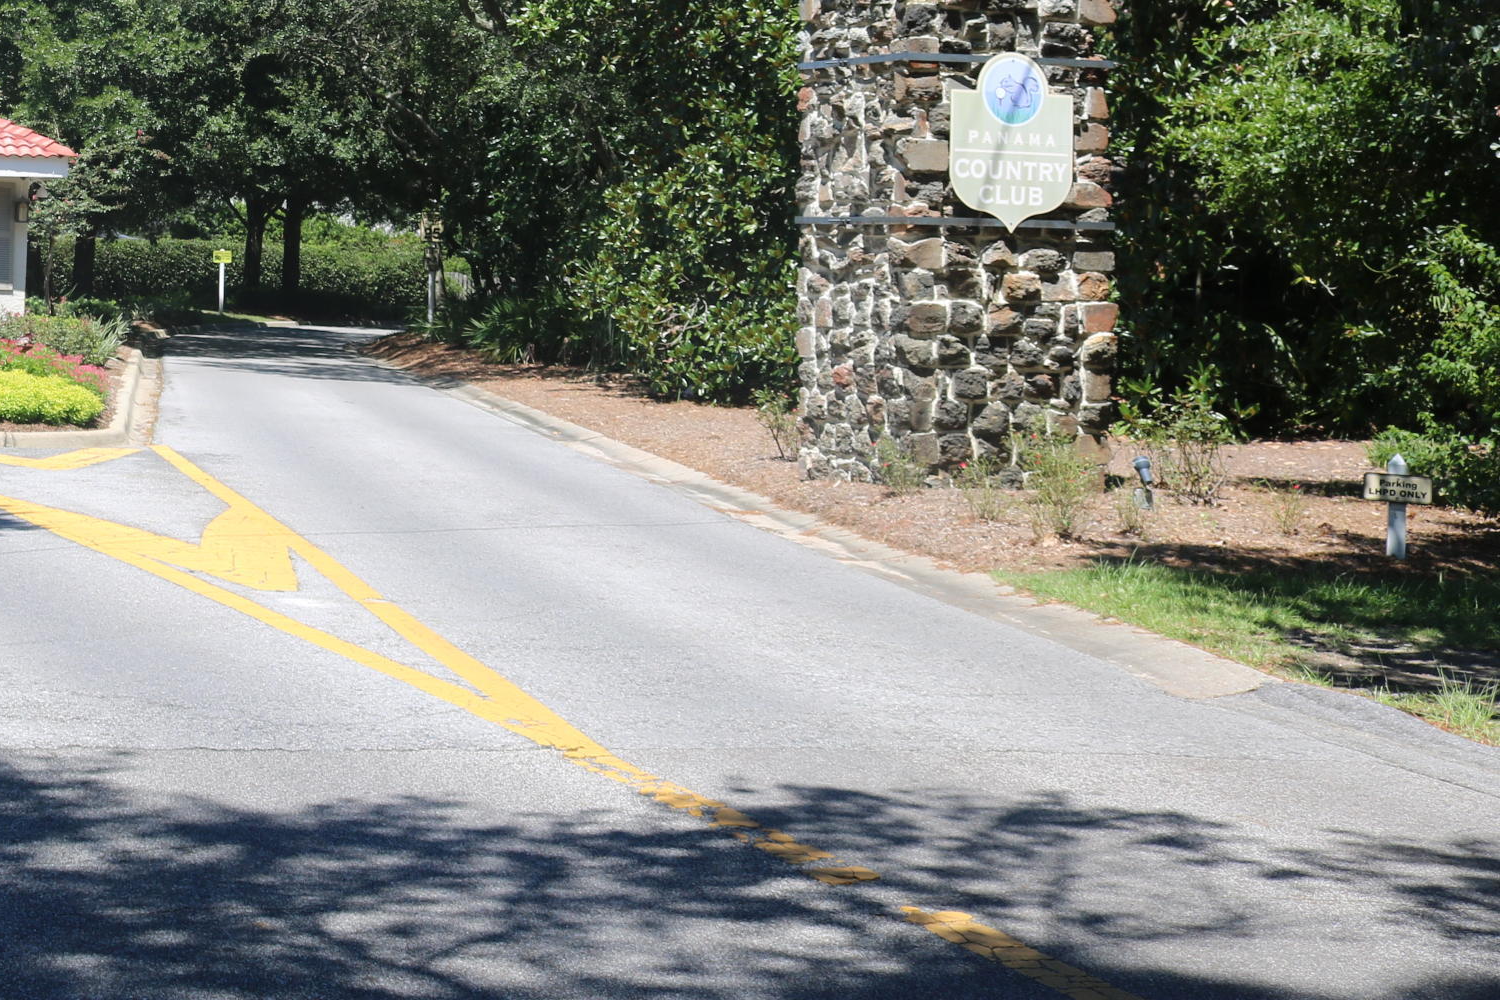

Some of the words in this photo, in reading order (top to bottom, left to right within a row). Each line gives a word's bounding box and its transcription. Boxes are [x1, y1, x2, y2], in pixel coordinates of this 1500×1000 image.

[968, 130, 1055, 147] PANAMA
[954, 158, 1068, 183] COUNTRY
[979, 184, 1044, 206] CLUB
[1380, 479, 1418, 490] Parking
[1368, 488, 1397, 497] LHPD
[1399, 489, 1428, 499] ONLY
